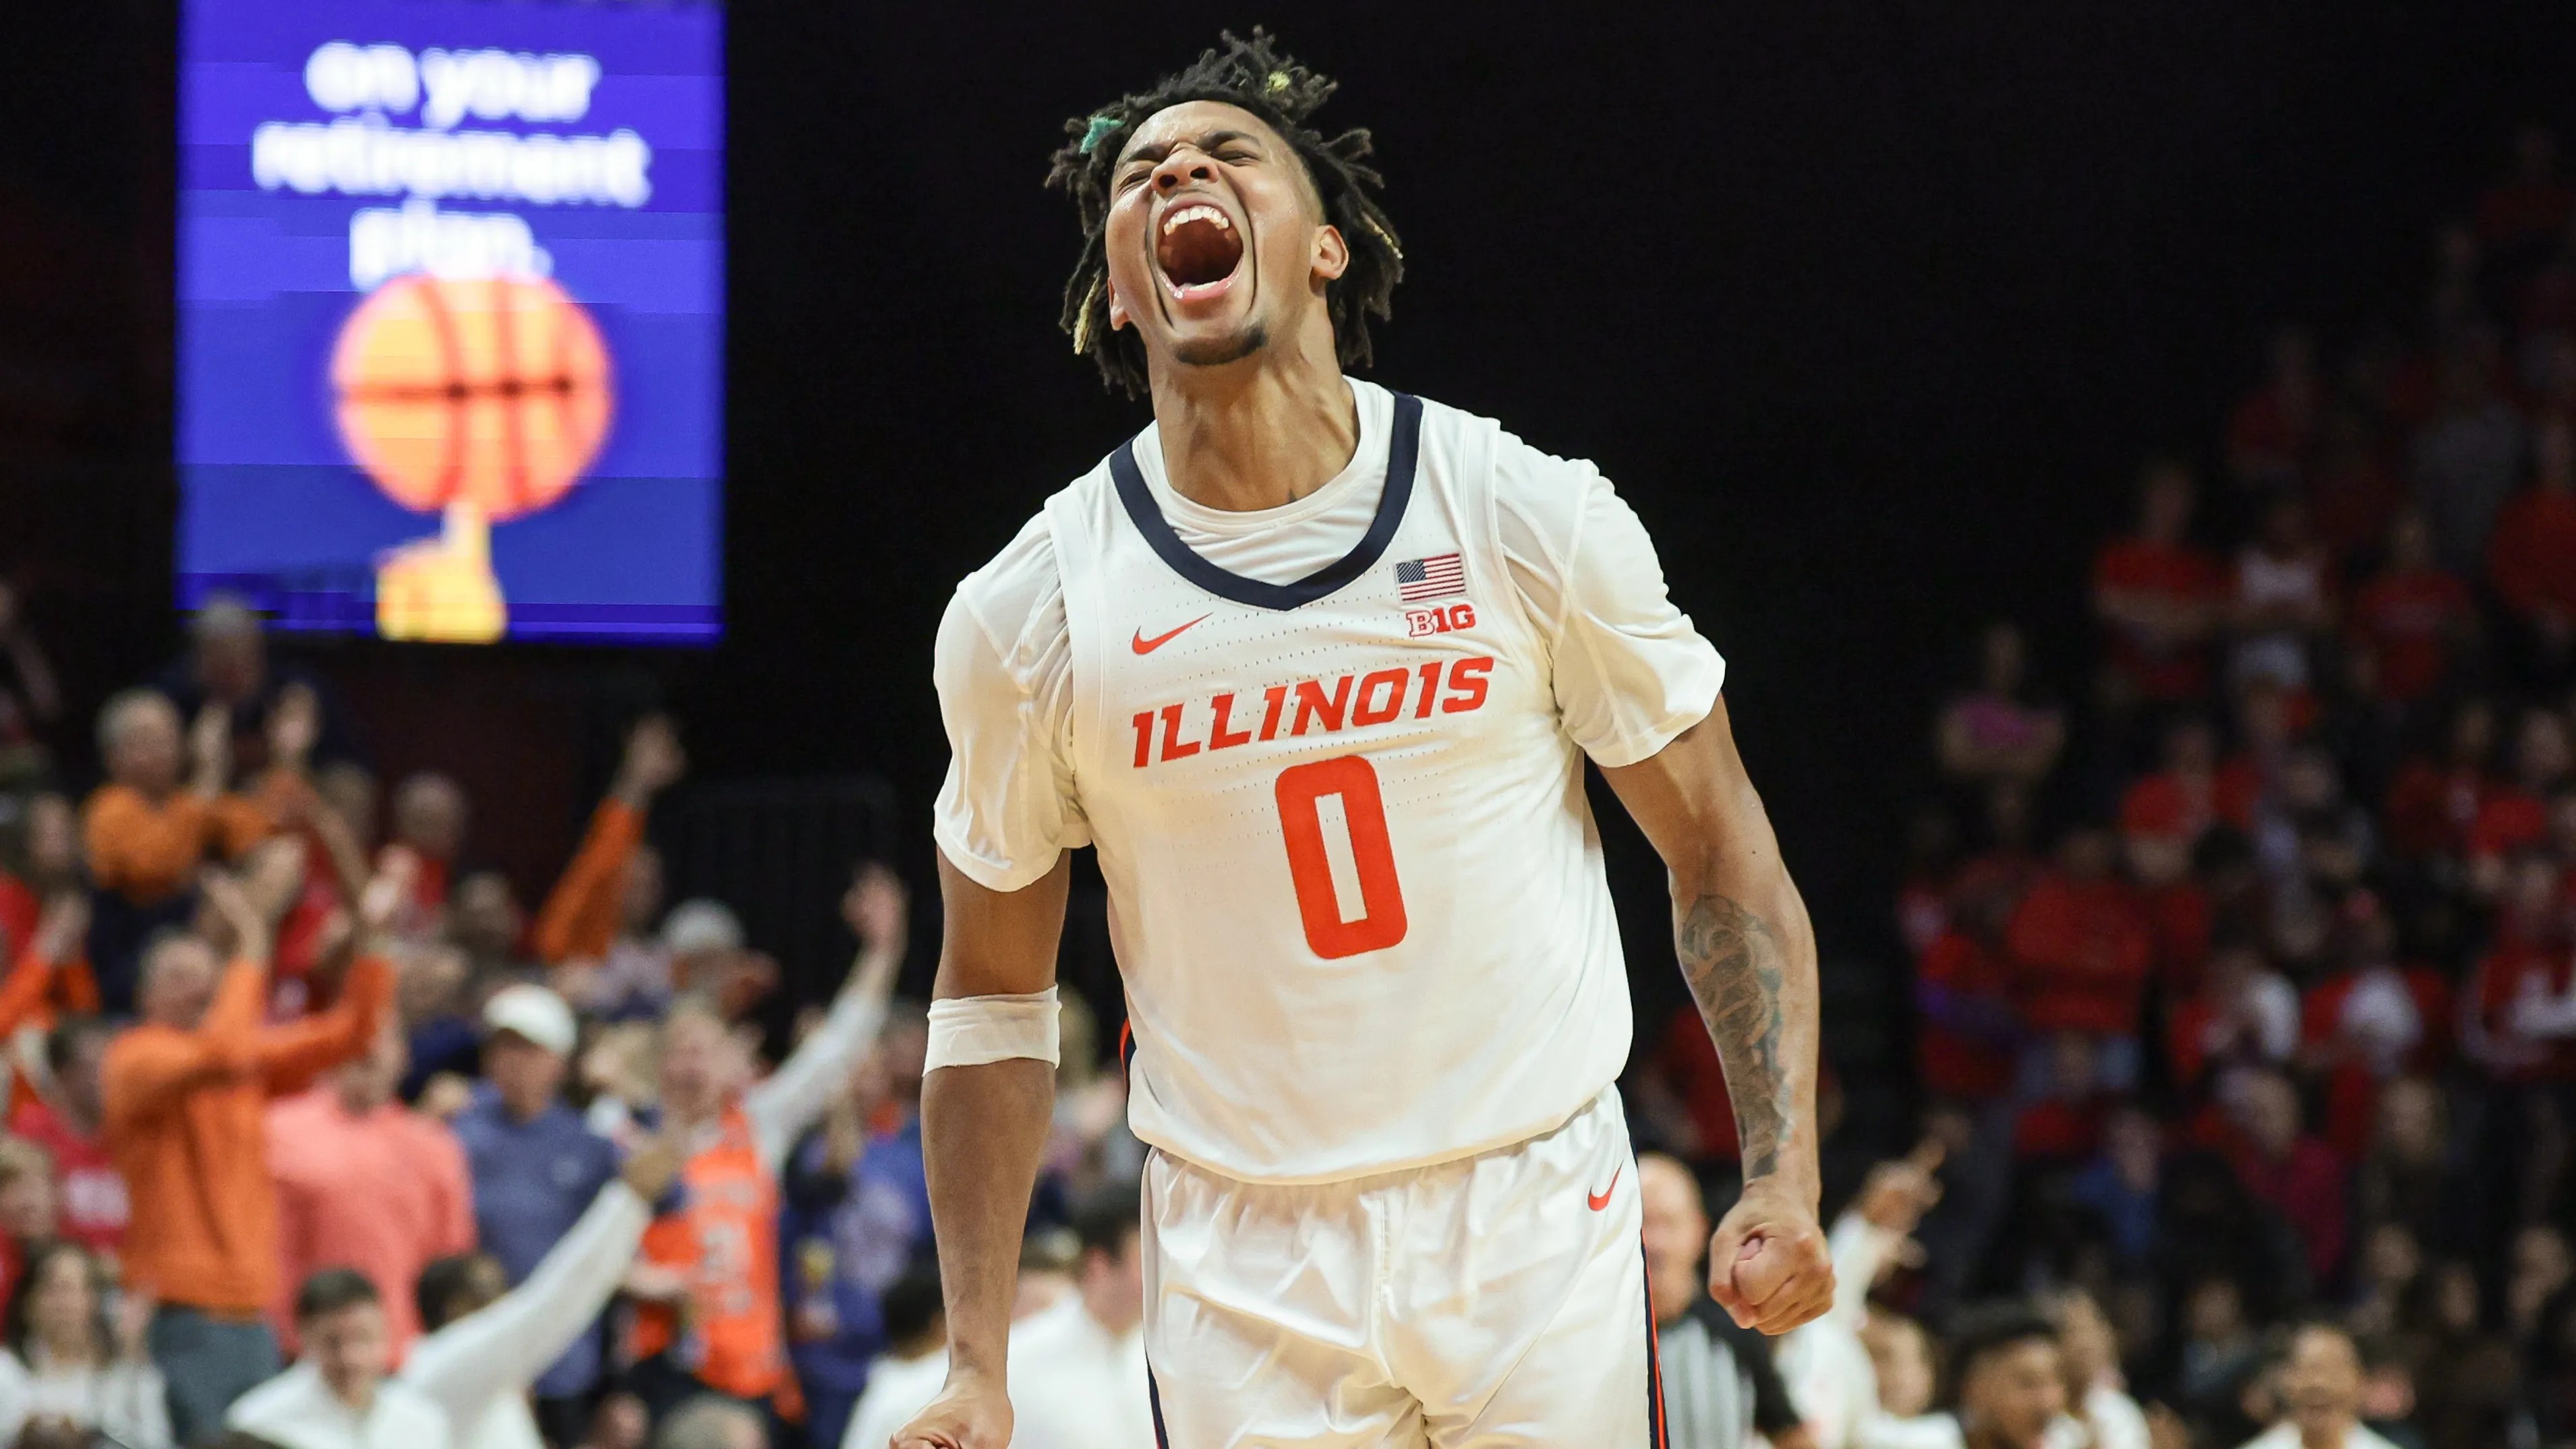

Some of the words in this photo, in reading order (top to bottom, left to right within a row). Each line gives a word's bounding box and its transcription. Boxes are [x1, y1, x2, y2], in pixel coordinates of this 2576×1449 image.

[305, 40, 419, 112] on
[419, 47, 601, 130] your
[252, 112, 651, 208] retirement
[1132, 656, 1494, 769] ILLINOIS
[1275, 755, 1408, 960] 0
